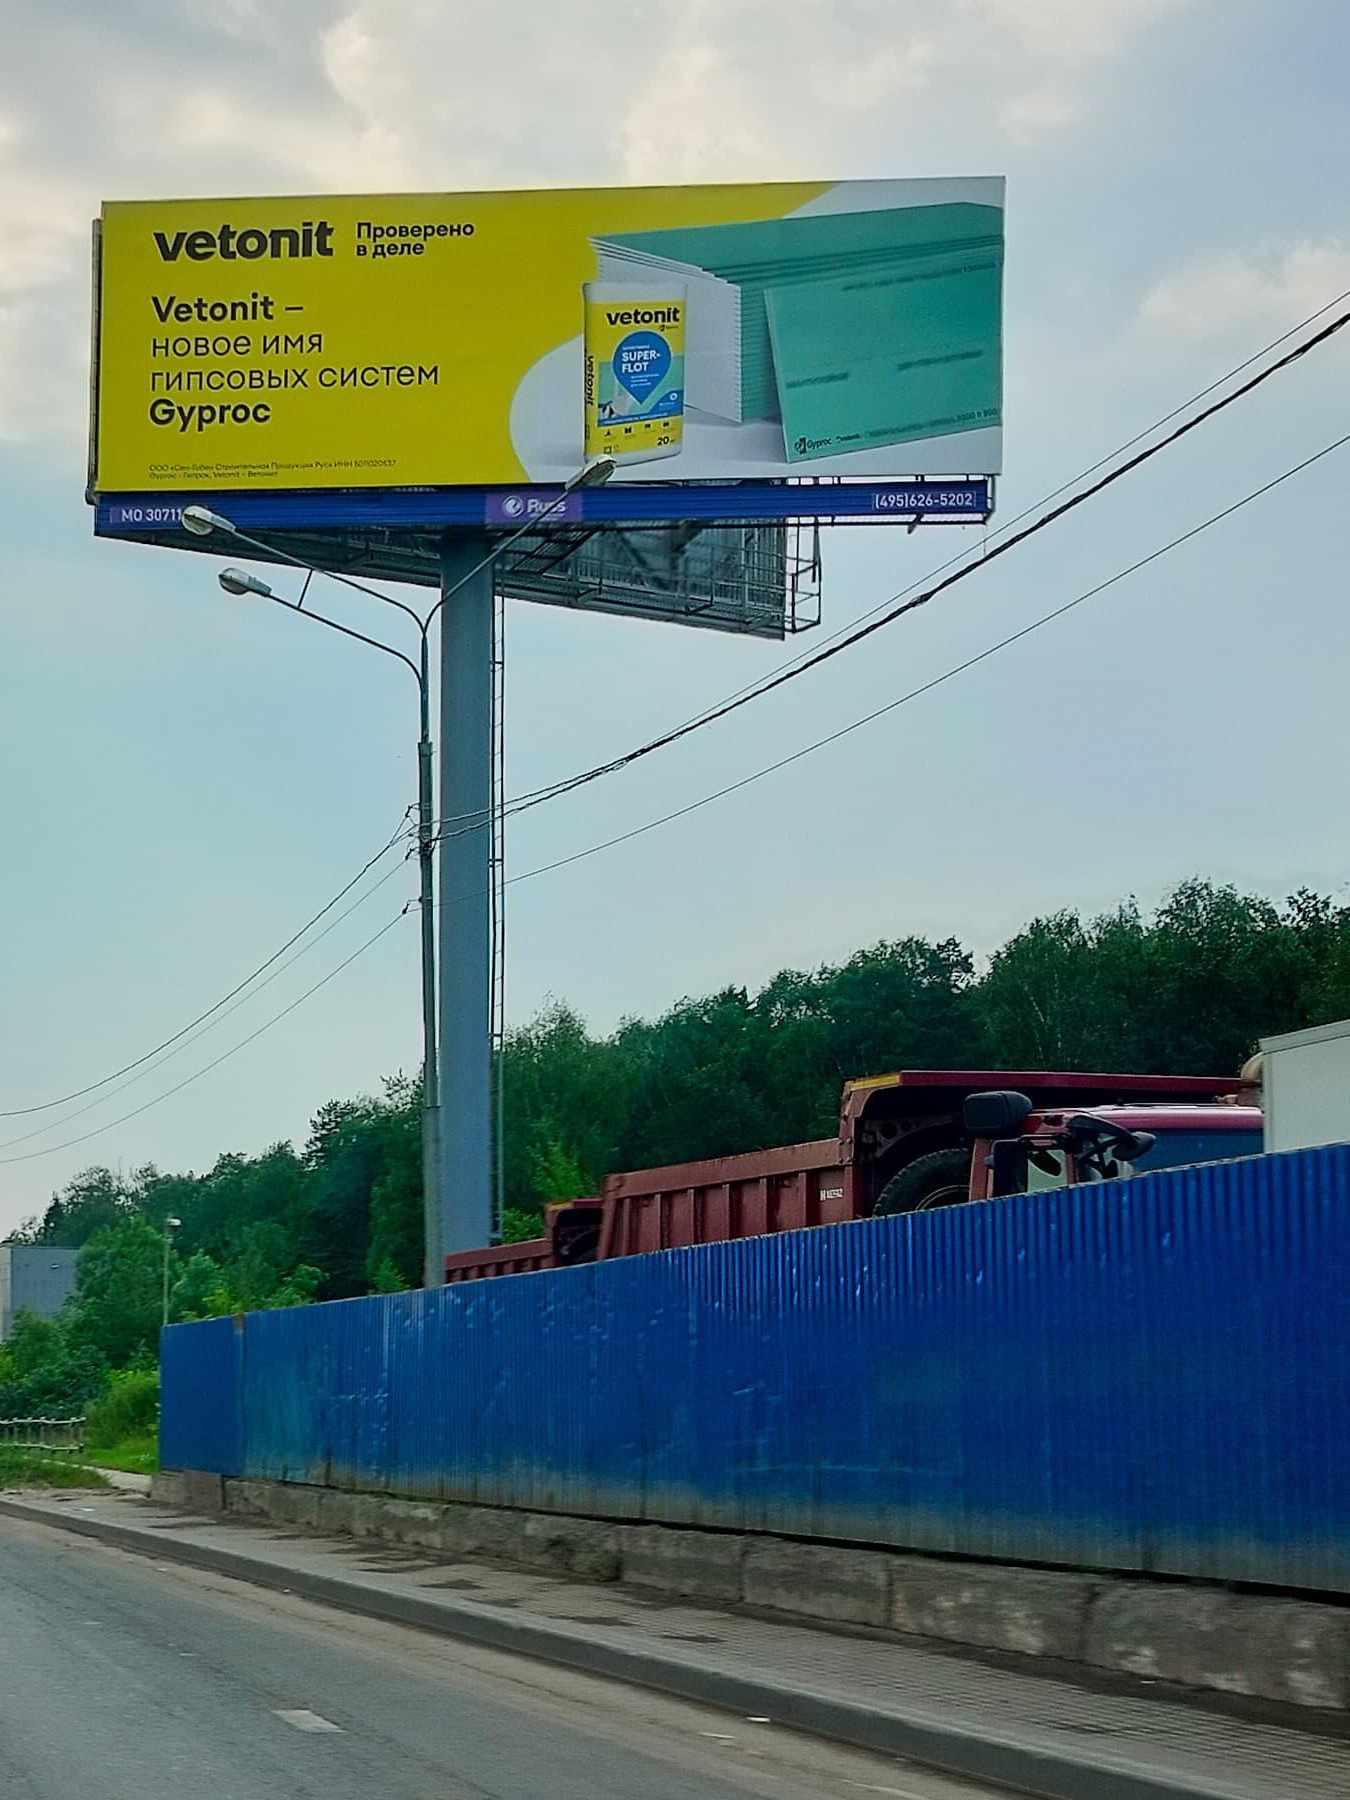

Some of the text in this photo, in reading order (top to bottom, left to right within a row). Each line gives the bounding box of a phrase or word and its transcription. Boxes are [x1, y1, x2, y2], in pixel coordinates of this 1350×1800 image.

[153, 221, 335, 262] vetonit
[357, 222, 475, 242] Проверено
[356, 241, 425, 258] в деле
[151, 292, 274, 322] Vetonit
[606, 307, 680, 326] vetonit
[152, 333, 323, 358] новое имя
[621, 350, 661, 362] SUPER-
[621, 361, 649, 374] FLOT
[151, 365, 439, 392] гипсовых систем
[586, 355, 595, 406] vetonit
[149, 398, 271, 433] Gyproc
[657, 436, 669, 446] 20
[121, 508, 143, 522] МО
